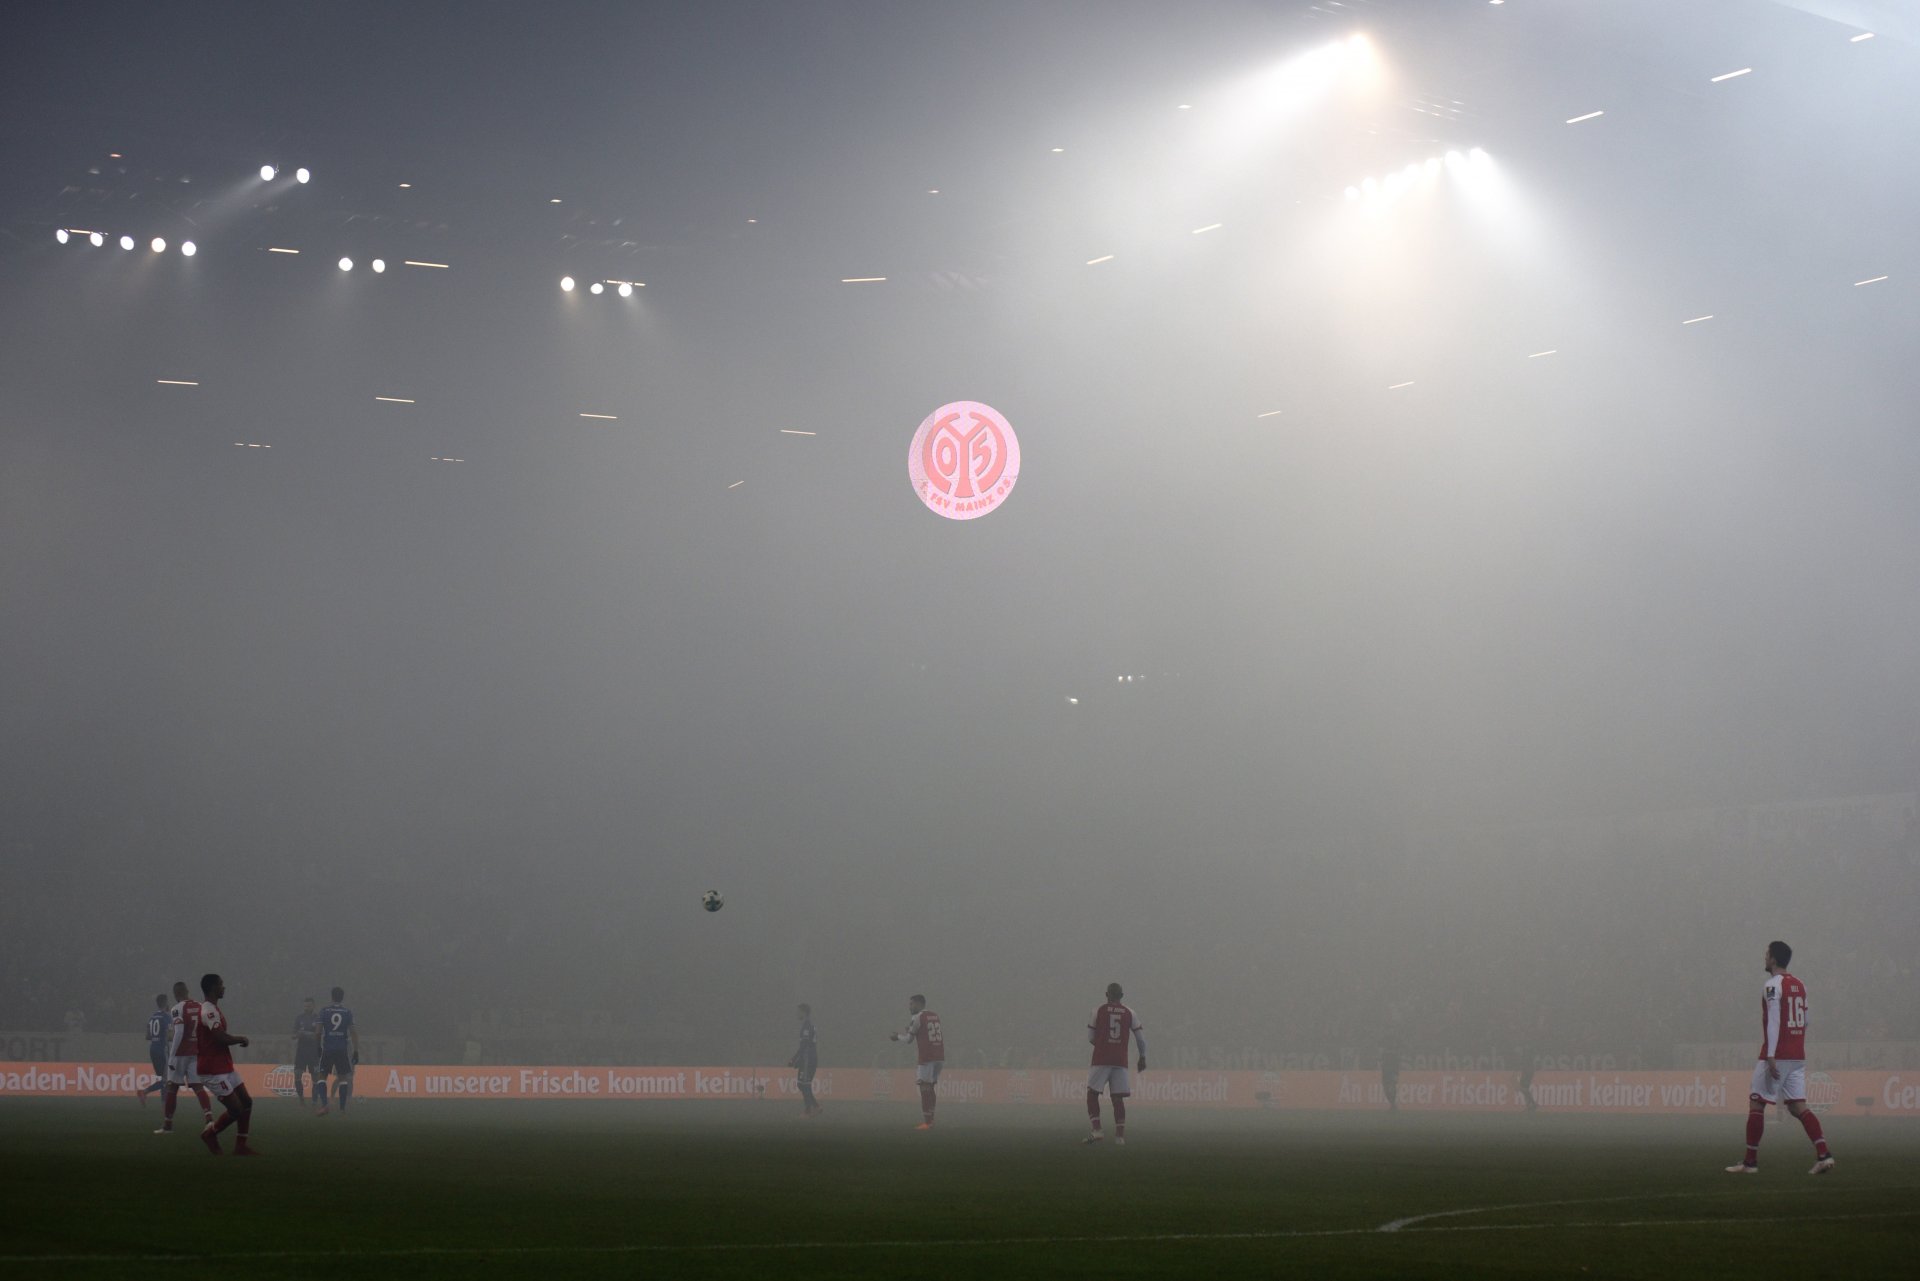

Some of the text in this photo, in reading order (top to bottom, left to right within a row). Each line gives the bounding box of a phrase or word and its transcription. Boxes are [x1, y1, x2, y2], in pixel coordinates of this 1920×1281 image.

[955, 494, 996, 512] MAINZ
[330, 1013, 342, 1031] 9
[1787, 996, 1805, 1028] 16
[149, 1018, 160, 1037] 10
[191, 1015, 199, 1037] 7
[927, 1022, 943, 1042] 23
[1109, 1014, 1121, 1039] 5
[384, 1069, 833, 1096] An unserer Frische kommt keiner vobei
[1338, 1074, 1363, 1104] An
[1441, 1075, 1508, 1106] Frische
[1589, 1075, 1654, 1108] keiner
[1660, 1075, 1727, 1108] vorbei
